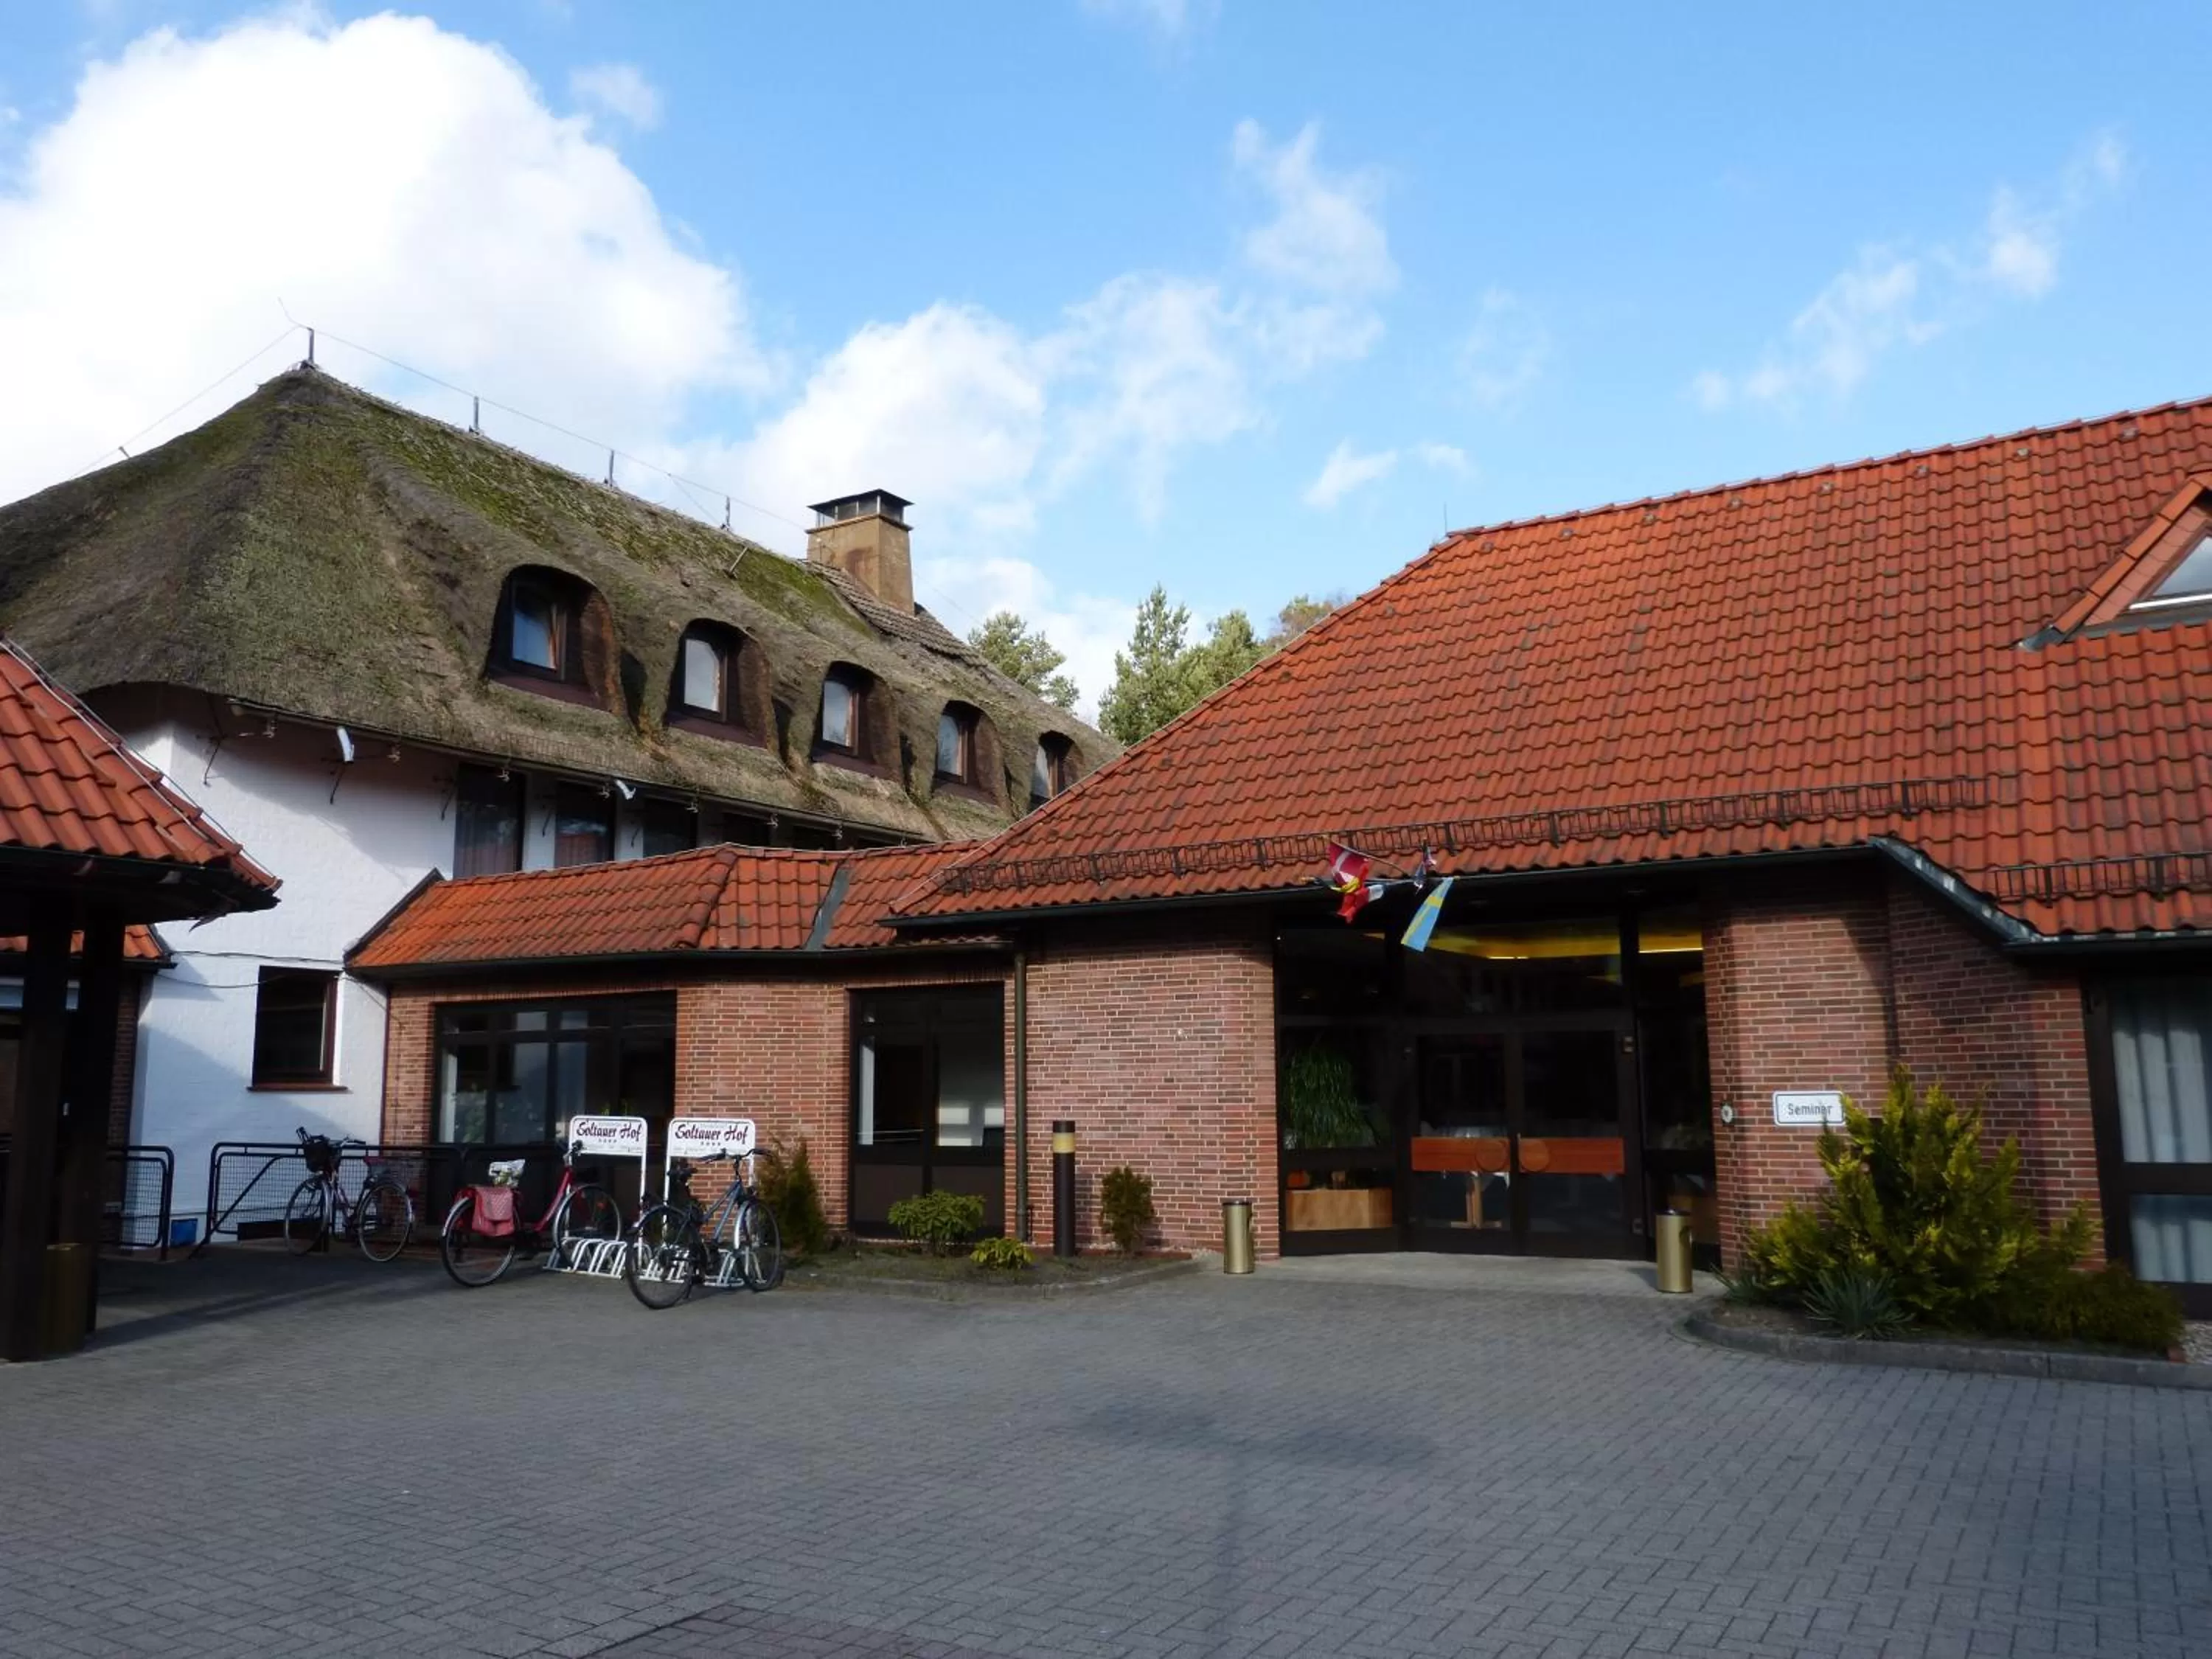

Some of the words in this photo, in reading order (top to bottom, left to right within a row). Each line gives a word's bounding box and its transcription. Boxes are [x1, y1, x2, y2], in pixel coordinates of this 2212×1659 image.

[577, 1121, 617, 1138] Soltauer
[619, 1121, 642, 1141] Hof
[675, 1124, 721, 1140] Soltauer
[723, 1124, 748, 1144] Hof
